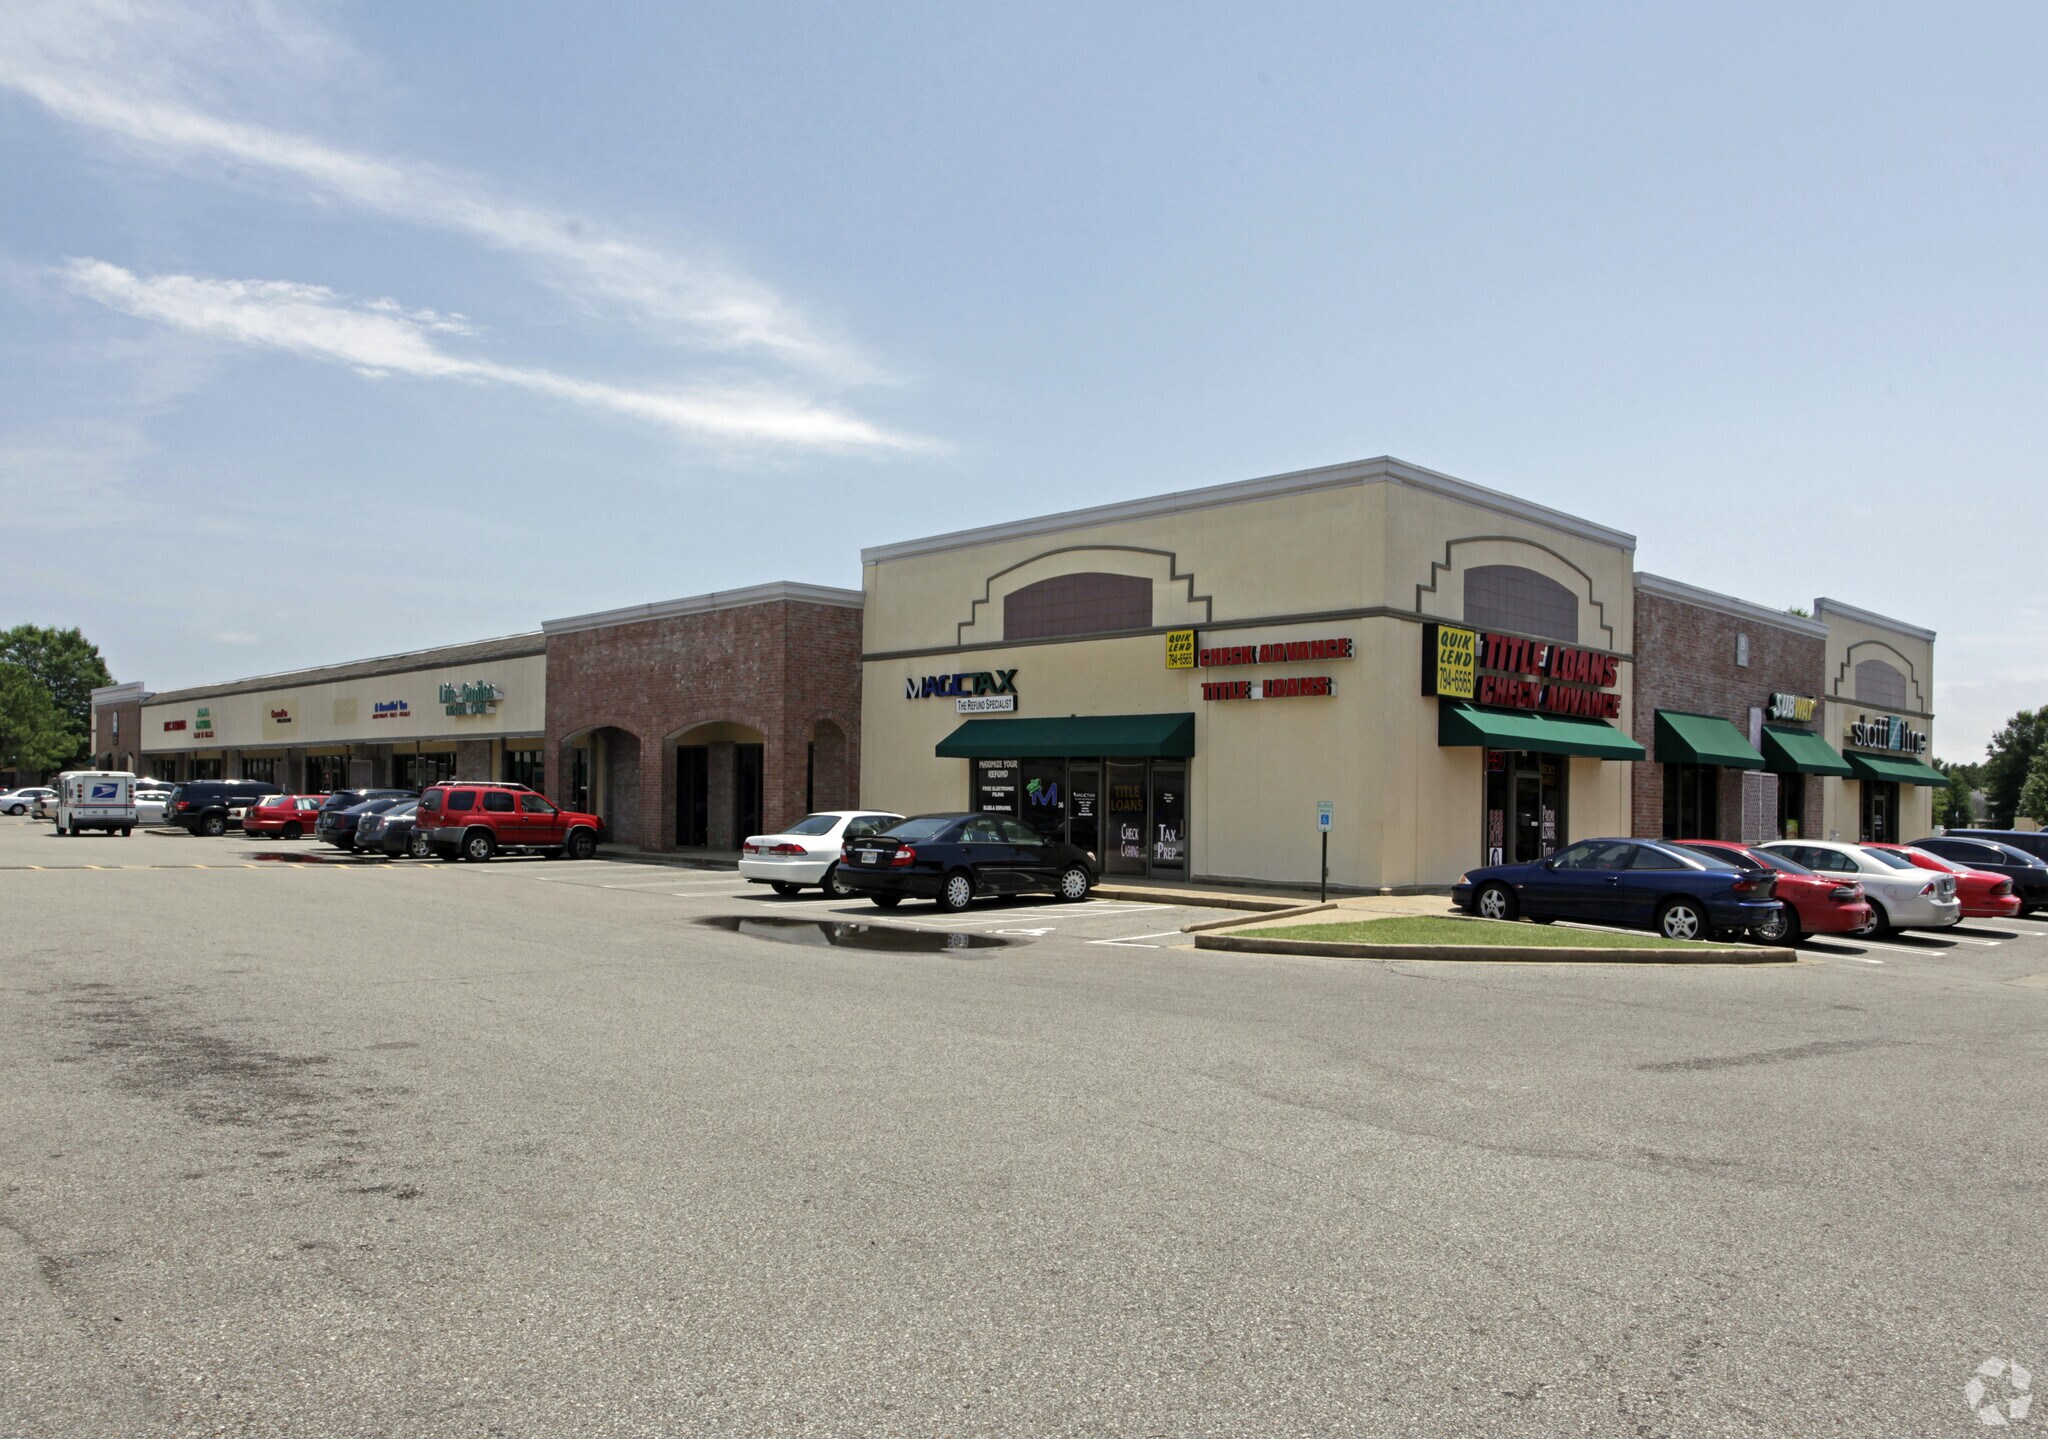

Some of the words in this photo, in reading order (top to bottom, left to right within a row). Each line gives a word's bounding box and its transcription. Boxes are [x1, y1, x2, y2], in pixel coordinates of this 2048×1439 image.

[1168, 633, 1191, 643] QUIK
[1168, 642, 1192, 652] LEND
[1441, 631, 1471, 650] QUIK
[1200, 645, 1256, 667] CHECK
[1258, 638, 1352, 664] ADVANCE
[1440, 649, 1472, 667] LEND
[1485, 633, 1546, 676] TITLE
[1551, 645, 1619, 688] LOANS
[1201, 680, 1251, 700] TITLE
[1262, 677, 1331, 698] LOANS
[1480, 674, 1543, 709] CHECK
[1547, 685, 1622, 719] ADVANCE
[958, 700, 967, 710] THE
[968, 700, 985, 710] REFUND
[986, 698, 1012, 710] SPECIALIST
[1772, 692, 1817, 721] SUBWAY
[1003, 760, 1018, 769] YOUR
[988, 770, 1009, 778] REFUND
[1114, 785, 1140, 798] TITLE
[1111, 799, 1143, 811] LOANS
[1121, 823, 1140, 840] CHECK
[1158, 823, 1176, 842] TAX
[1157, 842, 1176, 860] PREP
